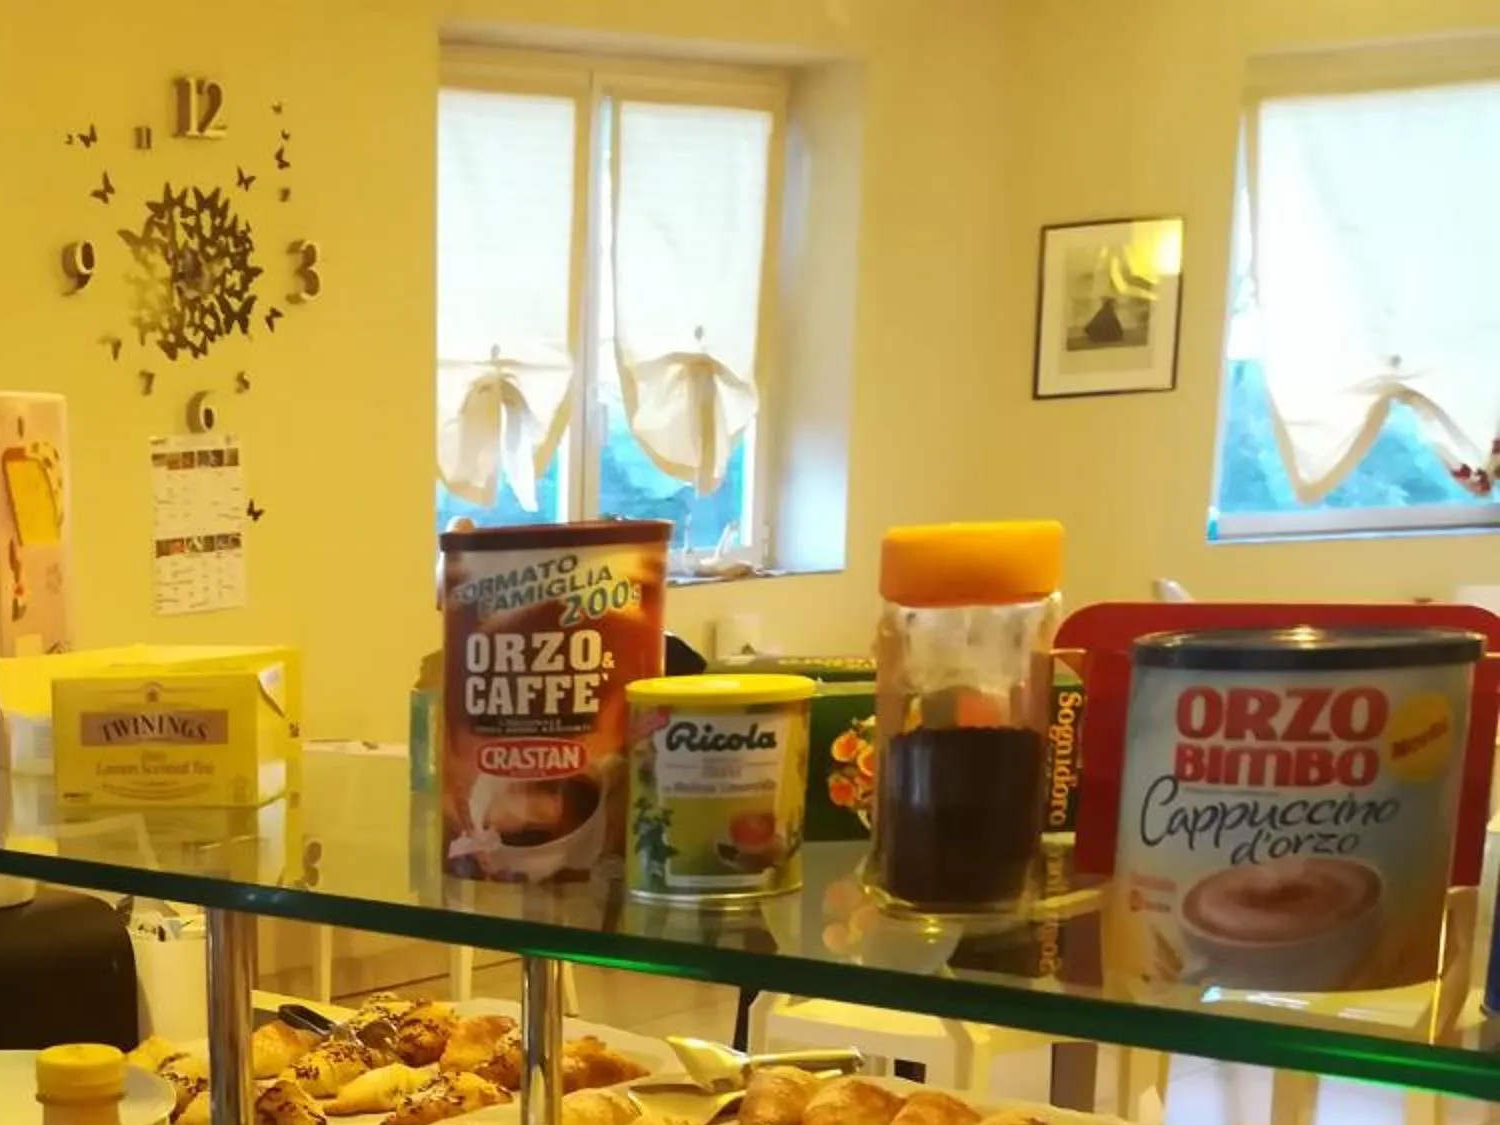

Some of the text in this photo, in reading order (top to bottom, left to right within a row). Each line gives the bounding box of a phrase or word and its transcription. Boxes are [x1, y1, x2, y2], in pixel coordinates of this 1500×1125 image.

[466, 629, 602, 674] ORZO
[102, 713, 209, 743] TWININGS
[1177, 685, 1390, 742] ORZO
[666, 722, 777, 752] Ricola
[481, 746, 580, 770] CRASTAN
[1175, 743, 1380, 788] BIMBO
[1140, 775, 1399, 851] Cappuccino
[1230, 829, 1361, 866] d'orzo
